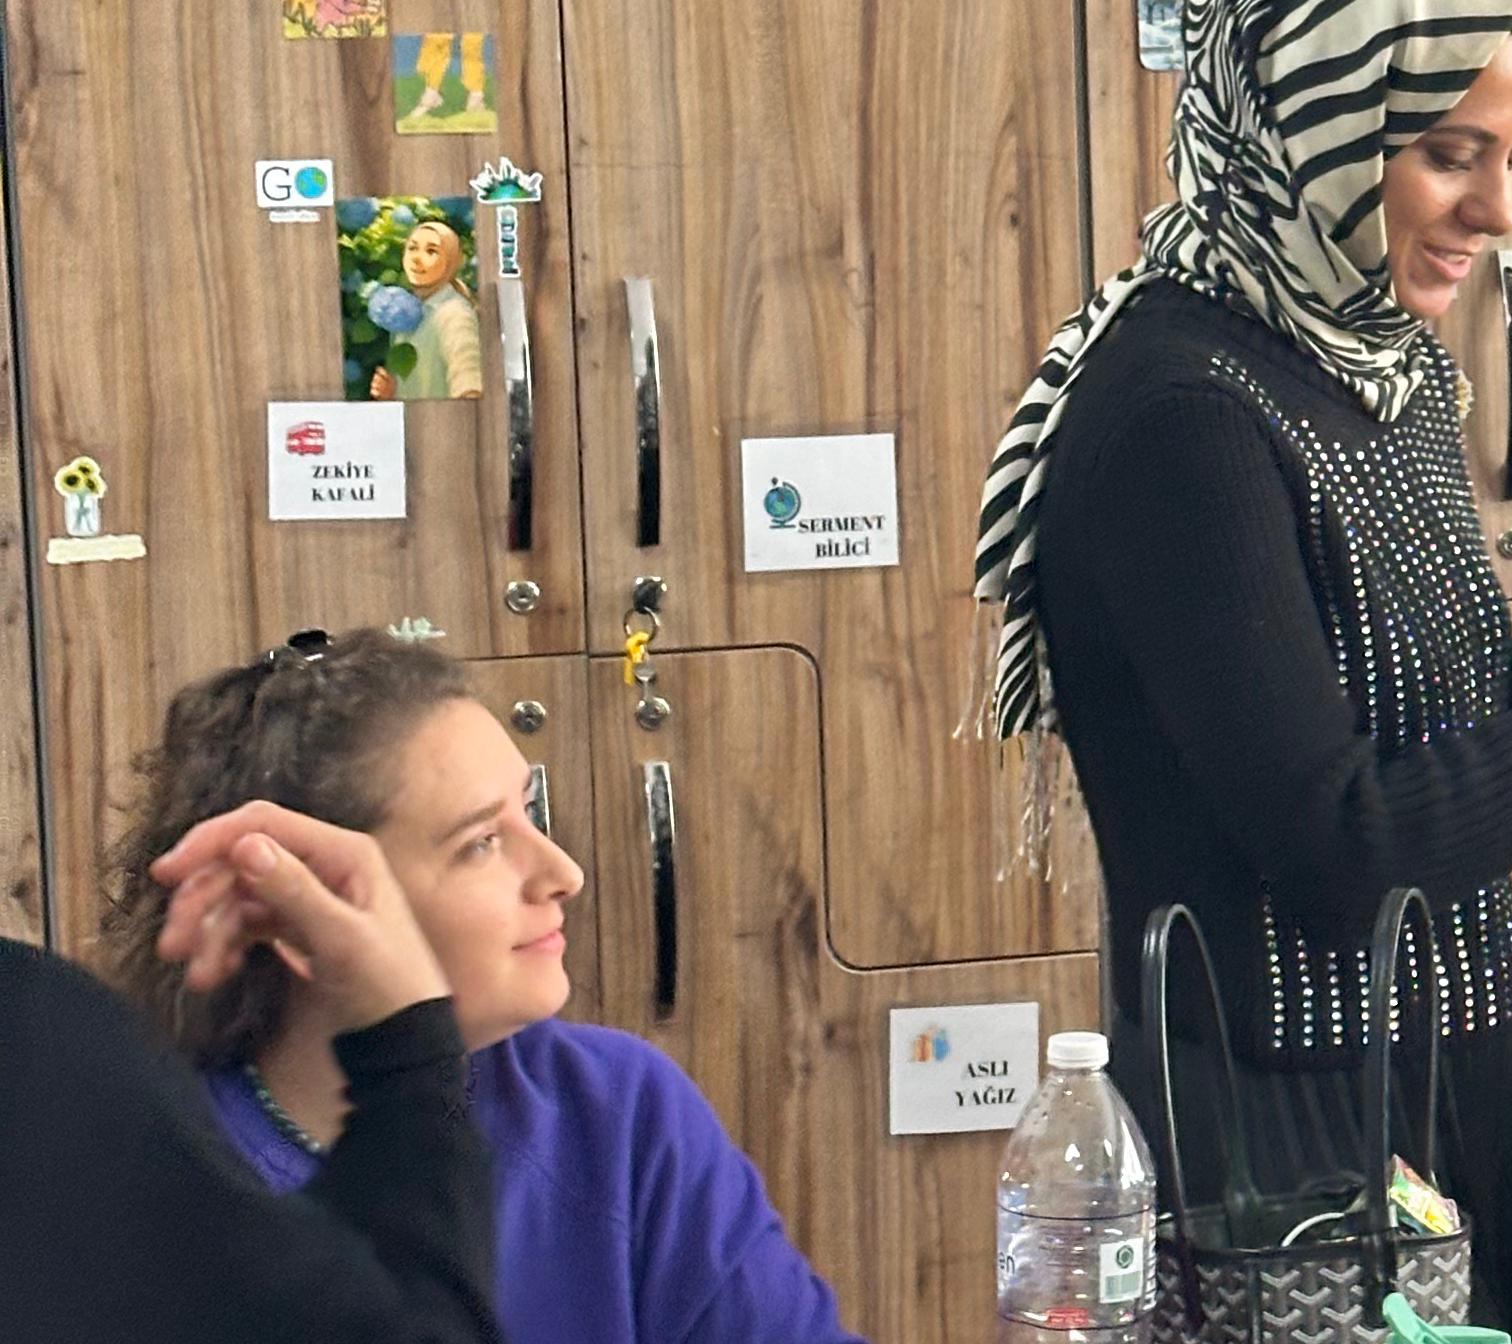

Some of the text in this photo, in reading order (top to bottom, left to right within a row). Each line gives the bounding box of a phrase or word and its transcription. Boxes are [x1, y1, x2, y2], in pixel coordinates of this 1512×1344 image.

[311, 460, 374, 479] ZEKİYE
[797, 514, 886, 534] SERMENT
[814, 536, 871, 558] BİLİCİ
[962, 1059, 1009, 1079] ASLI
[954, 1085, 1017, 1107] YAĞIZ
